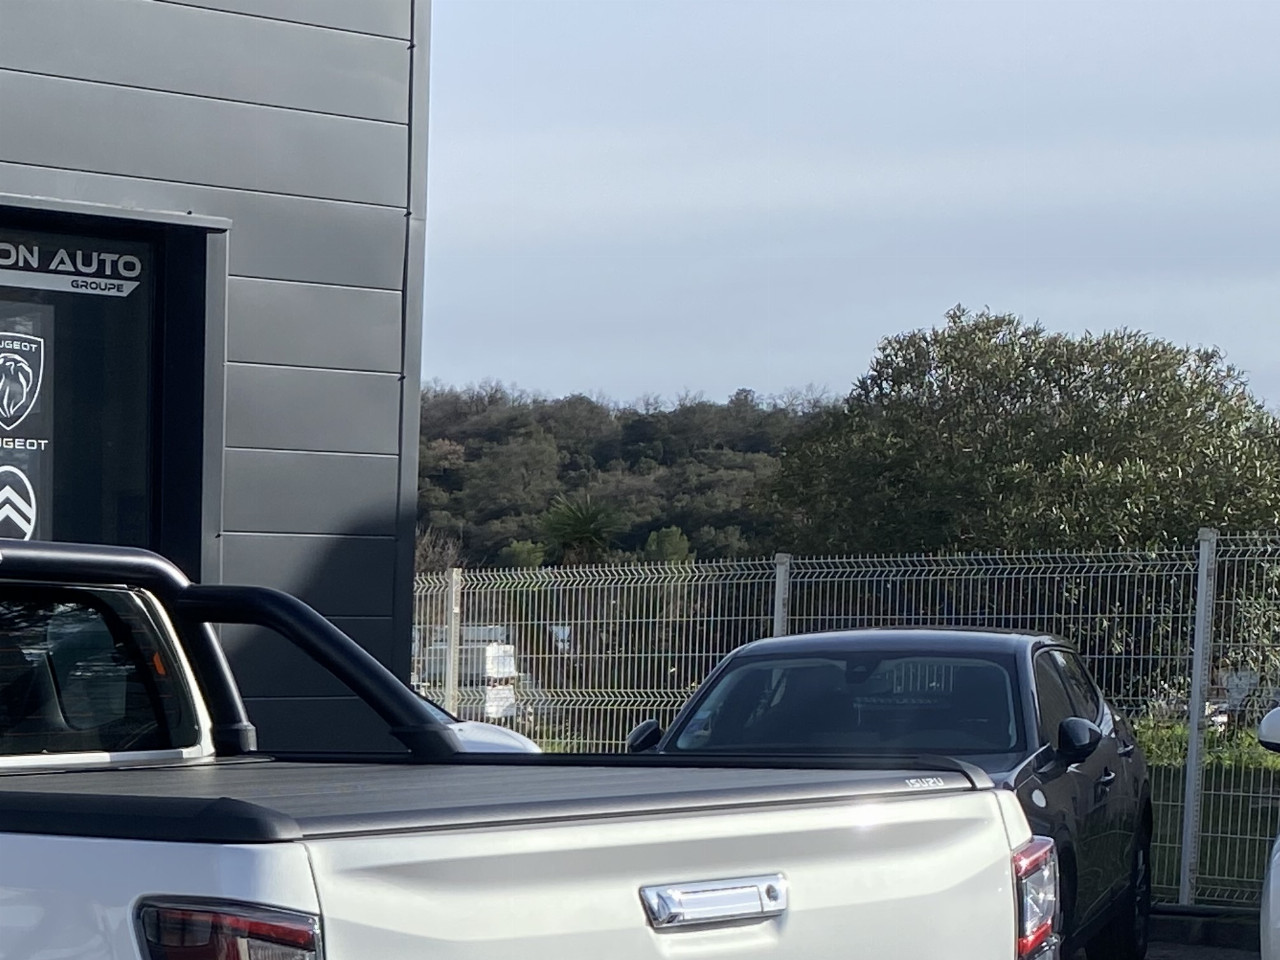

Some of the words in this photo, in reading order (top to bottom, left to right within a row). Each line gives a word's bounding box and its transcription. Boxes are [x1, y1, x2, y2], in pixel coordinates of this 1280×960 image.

[48, 248, 142, 277] AUTO
[70, 279, 124, 293] GROUPE
[906, 778, 944, 787] ISUZU
